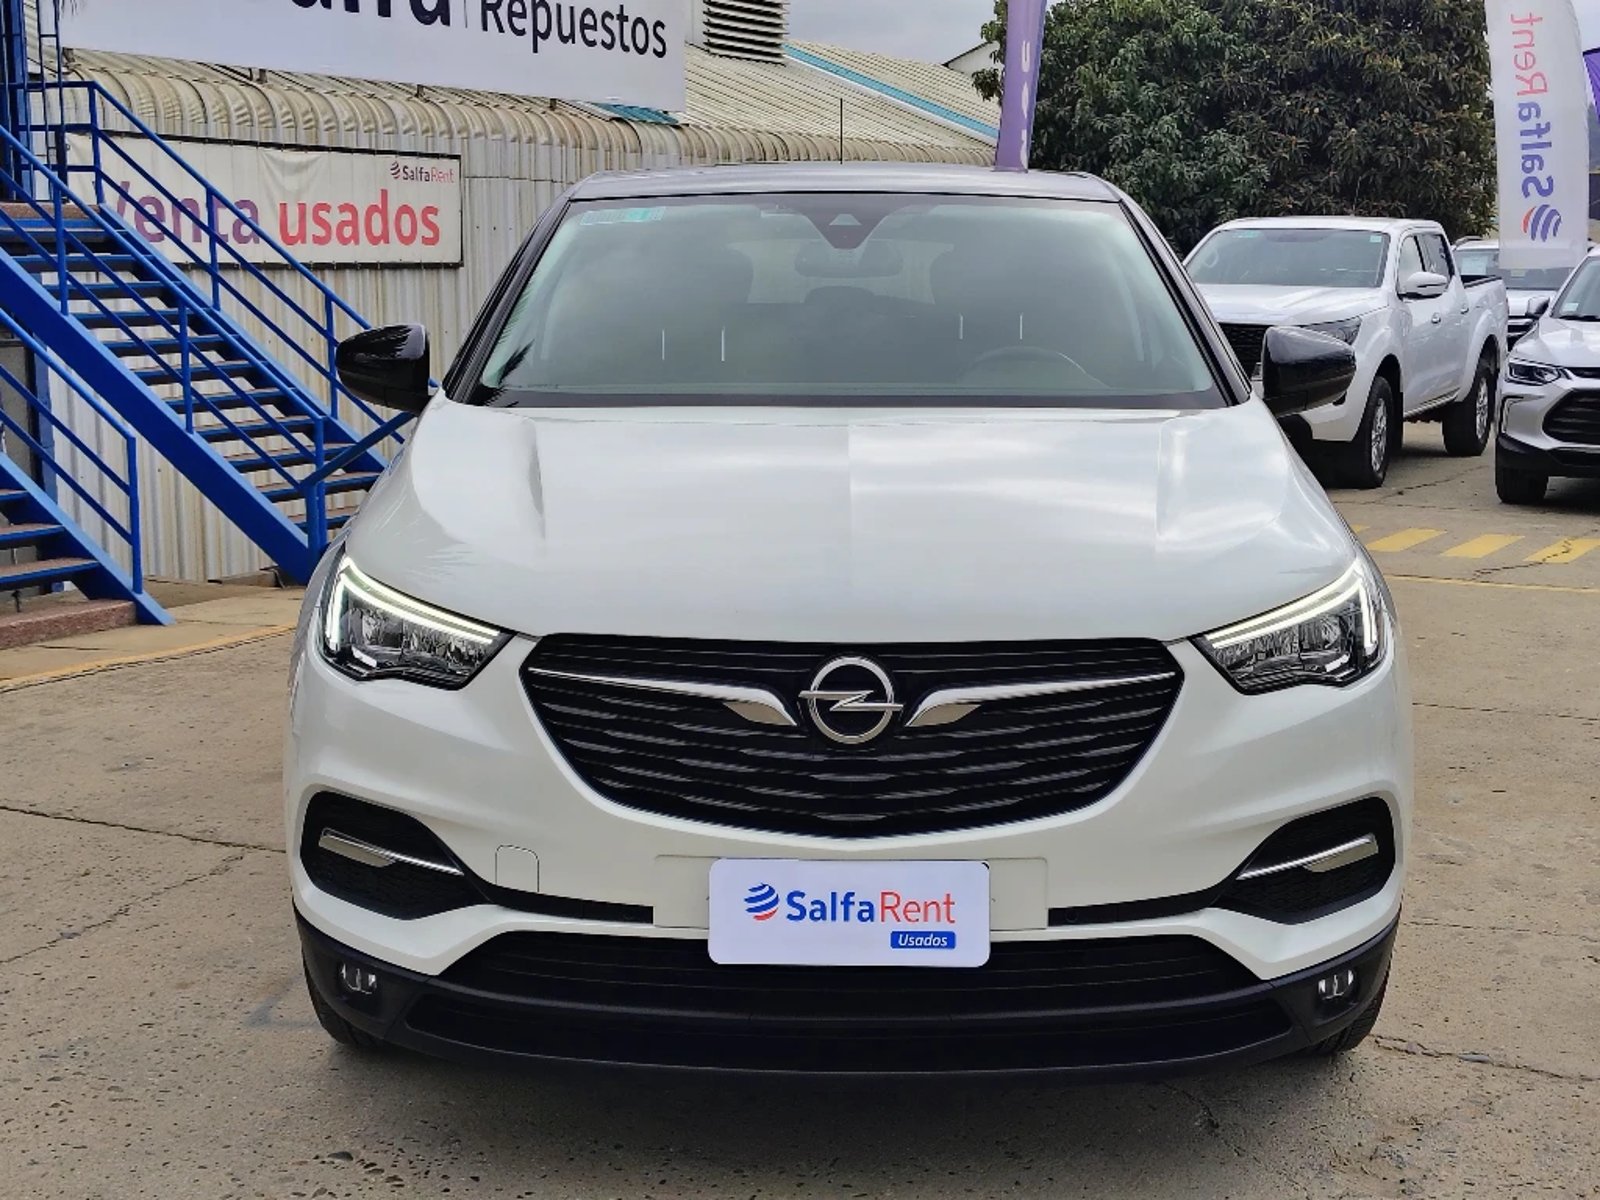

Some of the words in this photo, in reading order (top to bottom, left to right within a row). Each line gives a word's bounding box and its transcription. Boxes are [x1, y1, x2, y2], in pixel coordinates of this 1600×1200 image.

[481, 0, 667, 58] Repuestos
[402, 165, 455, 183] SalfaRent
[279, 188, 440, 246] usados
[785, 890, 955, 923] SalfaRent
[898, 933, 948, 948] Usados
